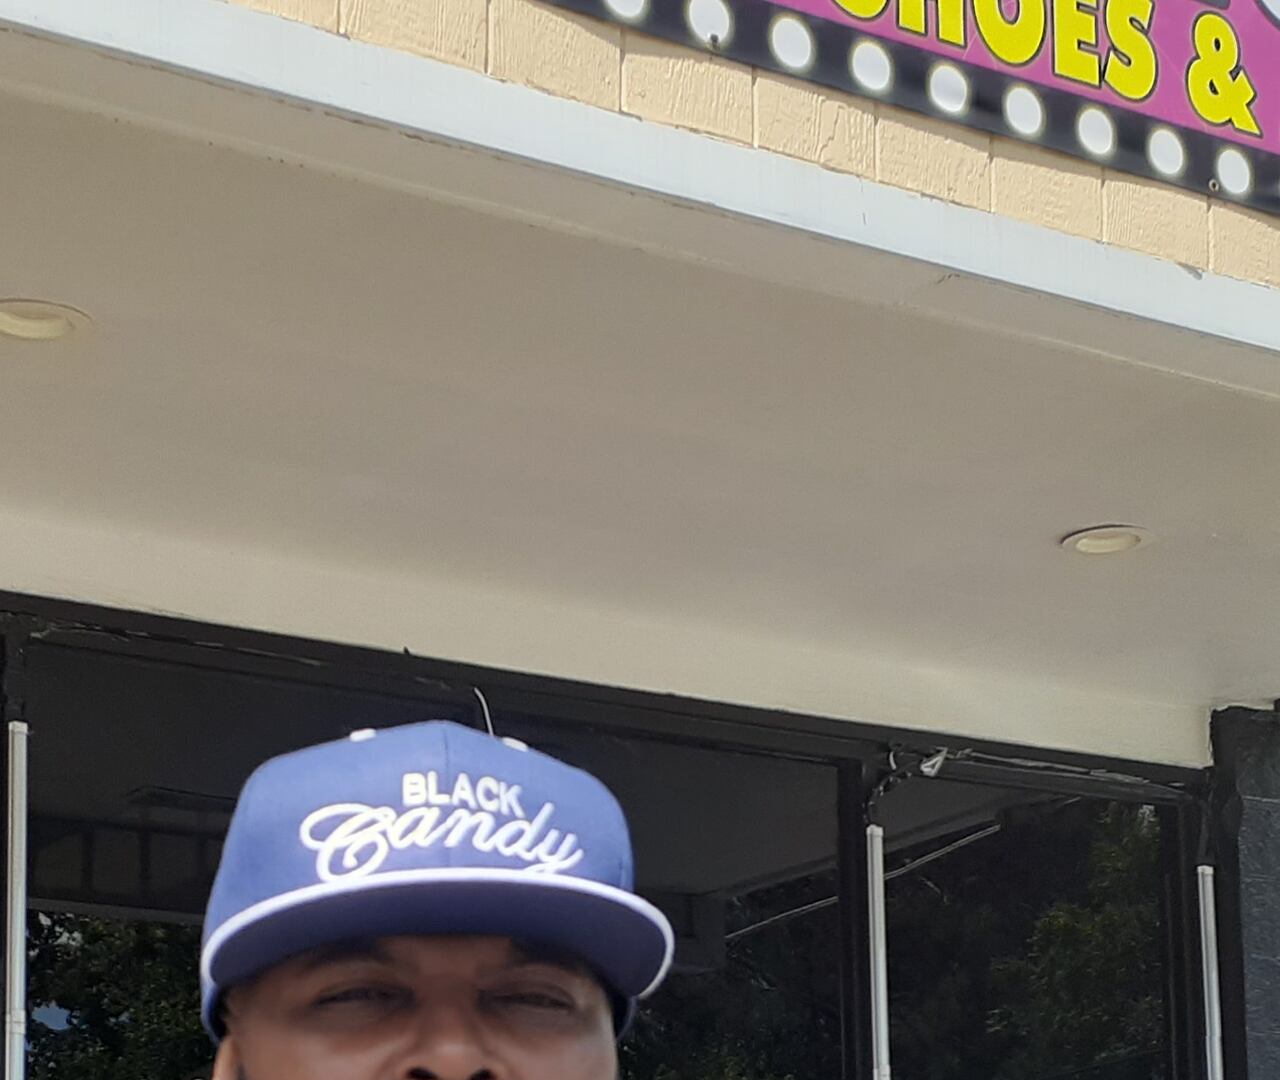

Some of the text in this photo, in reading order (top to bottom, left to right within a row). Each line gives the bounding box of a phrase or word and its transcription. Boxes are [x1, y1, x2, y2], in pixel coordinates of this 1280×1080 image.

[1187, 13, 1261, 136] &
[402, 772, 523, 817] BLACK
[299, 801, 584, 884] Candy
